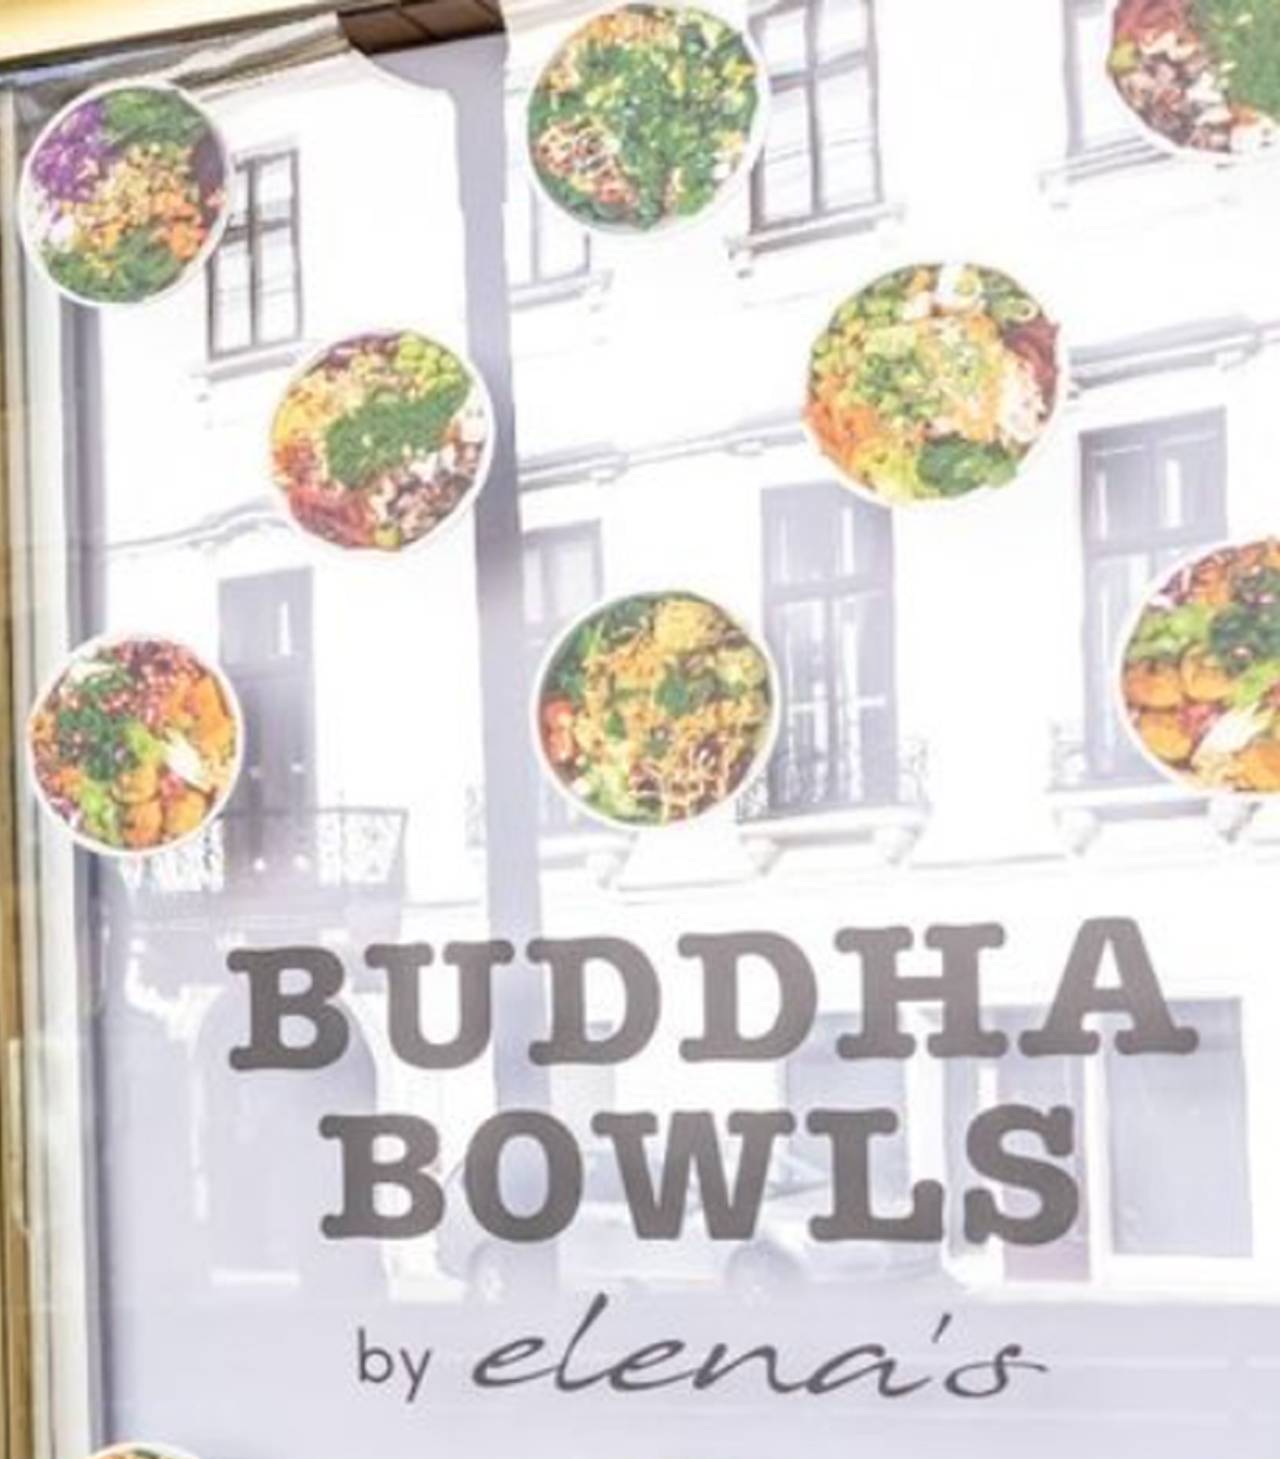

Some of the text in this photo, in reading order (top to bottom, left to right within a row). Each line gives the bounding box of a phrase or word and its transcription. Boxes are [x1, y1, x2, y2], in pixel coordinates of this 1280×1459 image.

[227, 916, 1198, 1070] BUDDHA
[318, 1102, 1078, 1244] BOWLS
[358, 1292, 1048, 1402] by elena's
